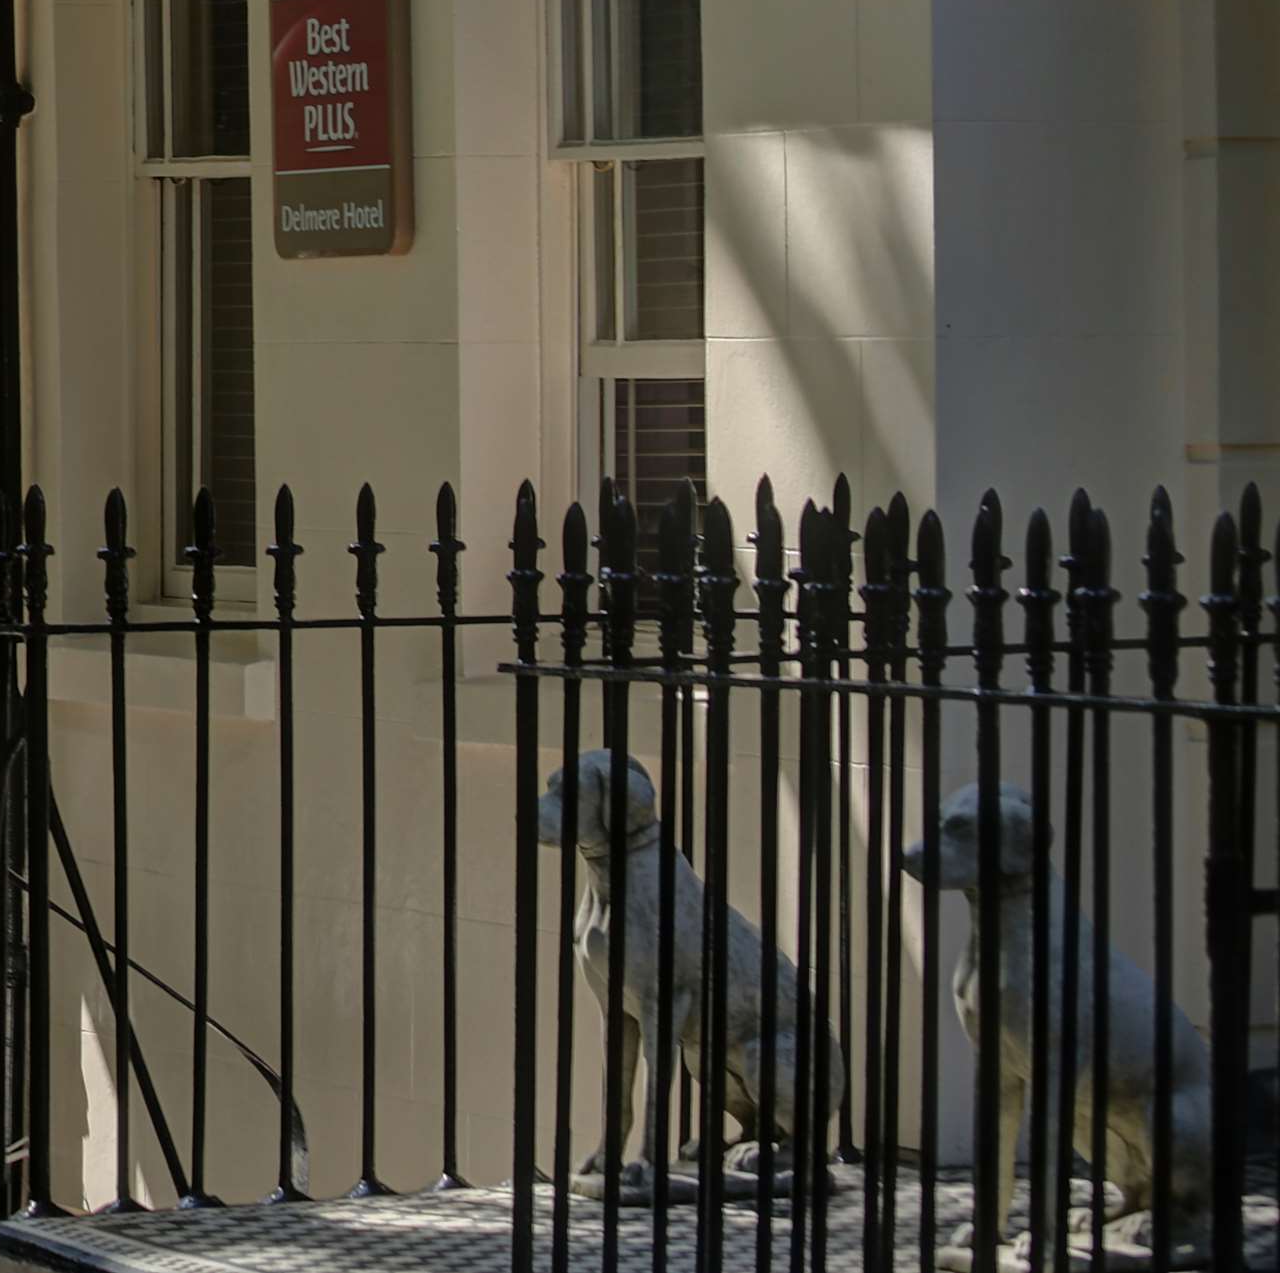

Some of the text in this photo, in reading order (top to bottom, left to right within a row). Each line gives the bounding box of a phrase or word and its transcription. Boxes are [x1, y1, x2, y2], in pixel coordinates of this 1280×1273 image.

[306, 17, 350, 56] Best
[289, 59, 369, 97] Western
[304, 102, 355, 142] PLUS
[281, 199, 384, 233] Delmere Hotel
